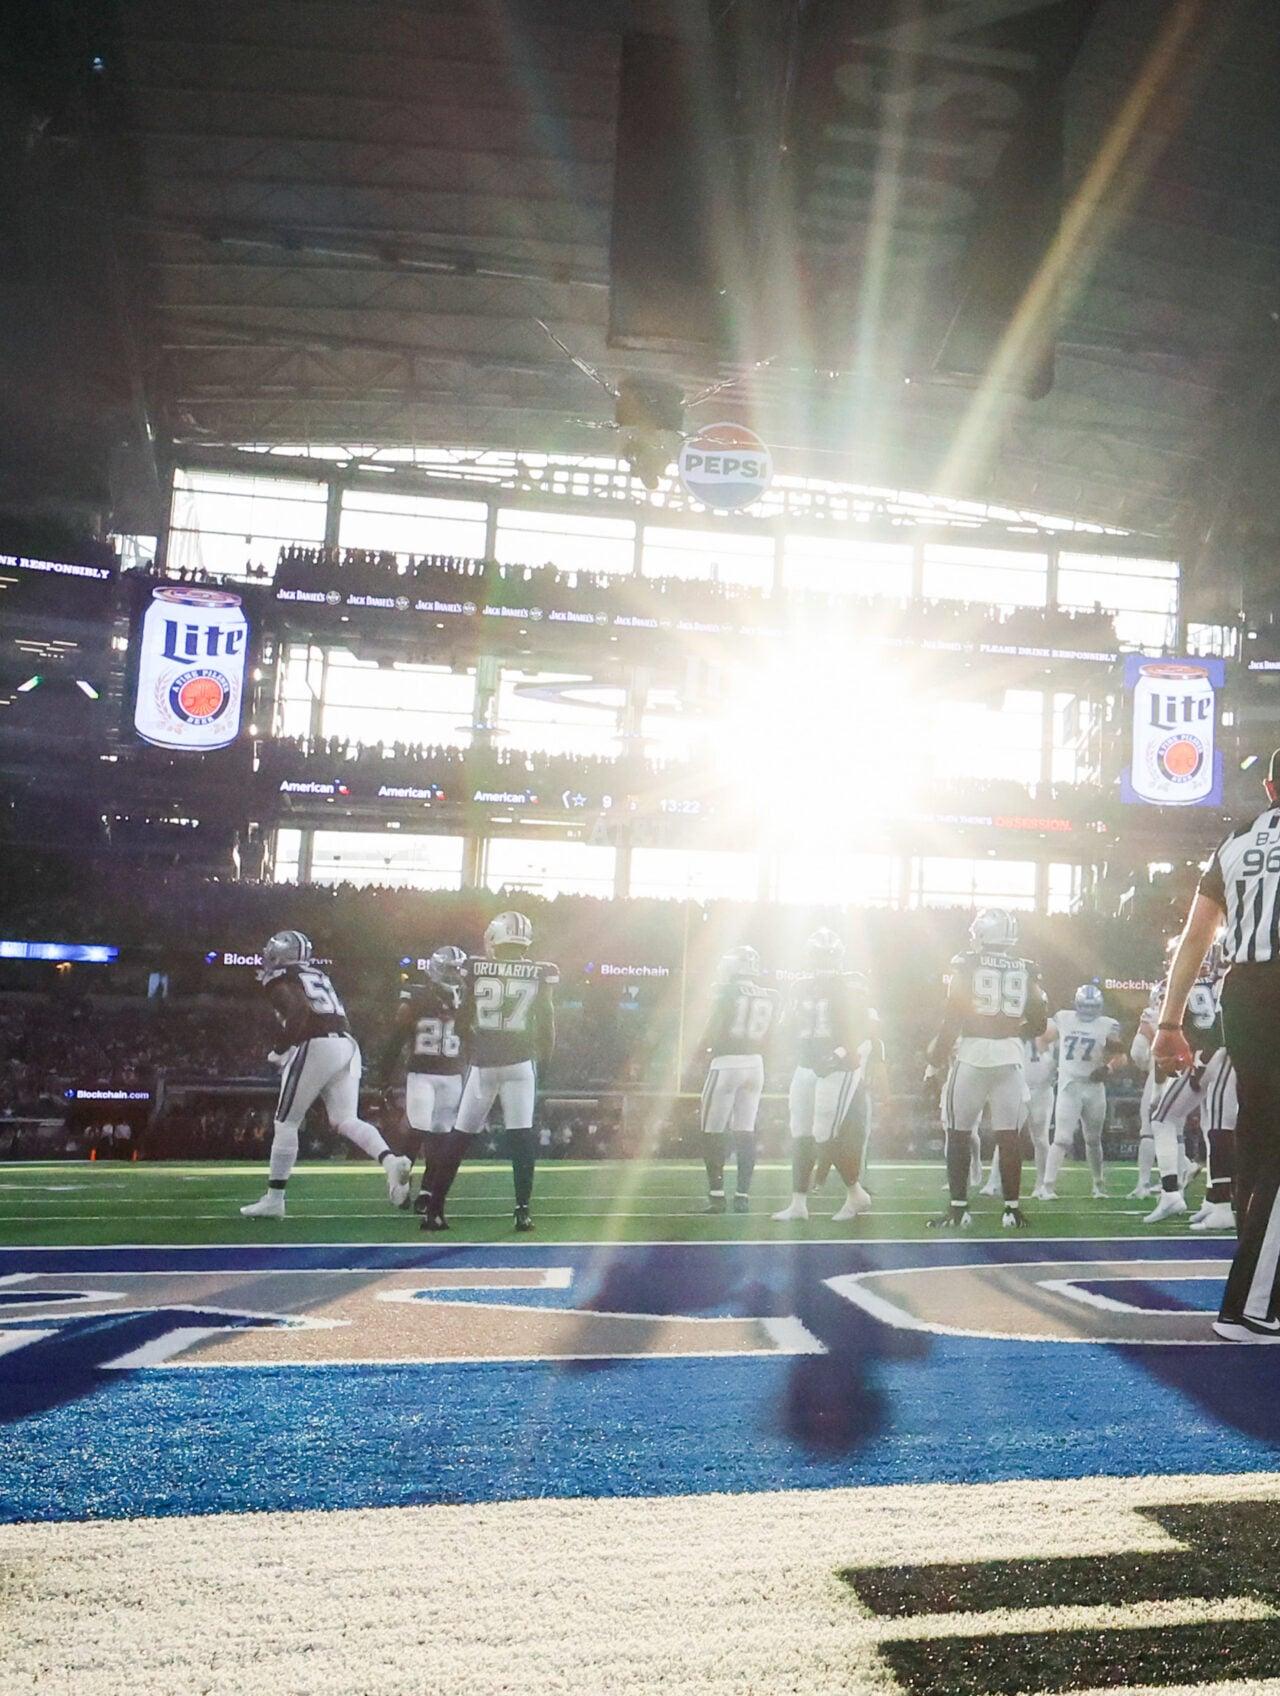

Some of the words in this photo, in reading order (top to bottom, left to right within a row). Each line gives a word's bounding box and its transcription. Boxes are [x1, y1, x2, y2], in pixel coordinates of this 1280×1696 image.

[685, 454, 767, 479] PEPSI
[19, 558, 110, 580] RESPONSIBLY
[160, 618, 243, 665] Lite
[1018, 645, 1050, 658] DRINK
[1051, 648, 1118, 662] RESPONSIBLY
[1149, 692, 1211, 731] Lite
[279, 780, 335, 794] American
[378, 786, 431, 799] American
[473, 790, 525, 804] American
[600, 964, 670, 977] Blockchain
[298, 972, 346, 1017] 5
[474, 976, 540, 1031] 27
[973, 968, 1029, 1018] 99
[414, 1018, 460, 1058] 26
[1064, 1035, 1096, 1061] 77
[76, 1089, 150, 1100] Blockchain.com
